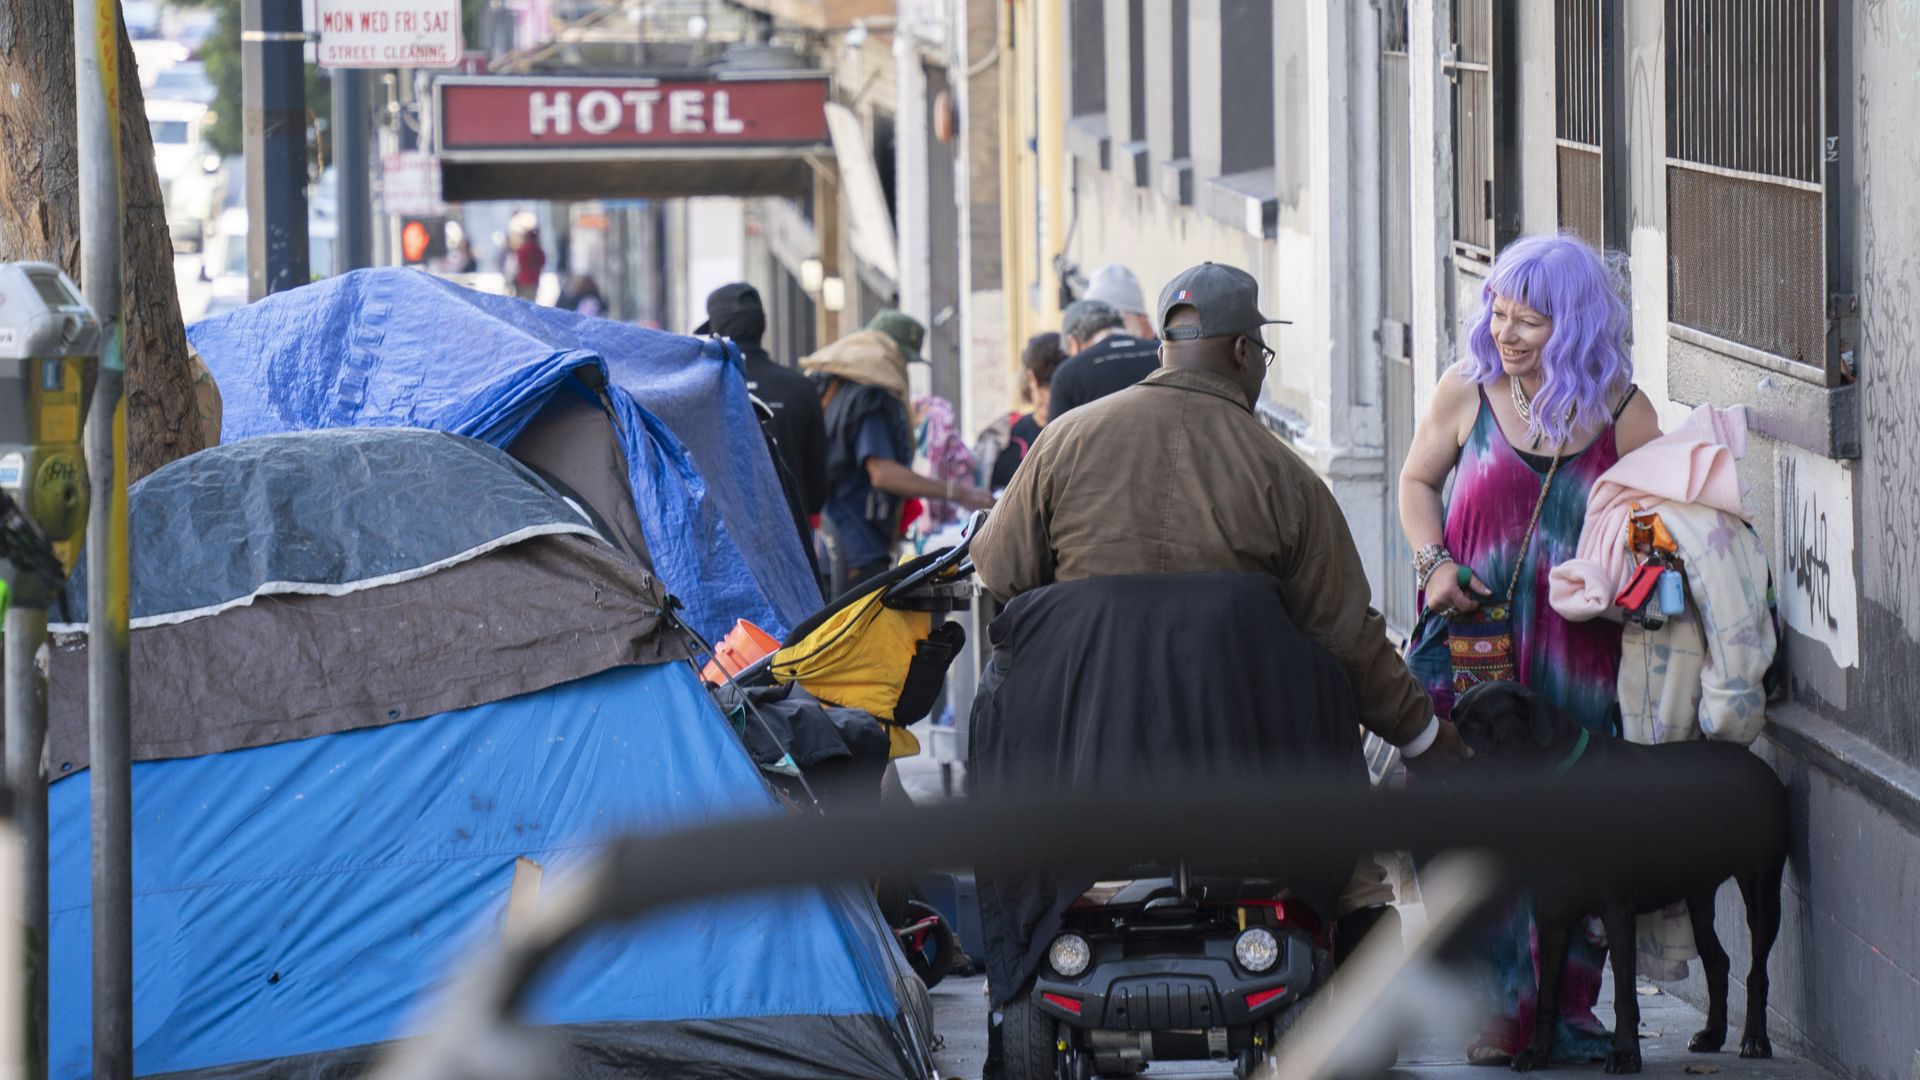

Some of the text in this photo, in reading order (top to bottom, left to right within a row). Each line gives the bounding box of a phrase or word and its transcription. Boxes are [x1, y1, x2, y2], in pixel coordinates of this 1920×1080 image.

[323, 11, 448, 33] MON WED FRI SAT
[329, 46, 376, 60] STREET
[529, 90, 744, 135] HOTEL
